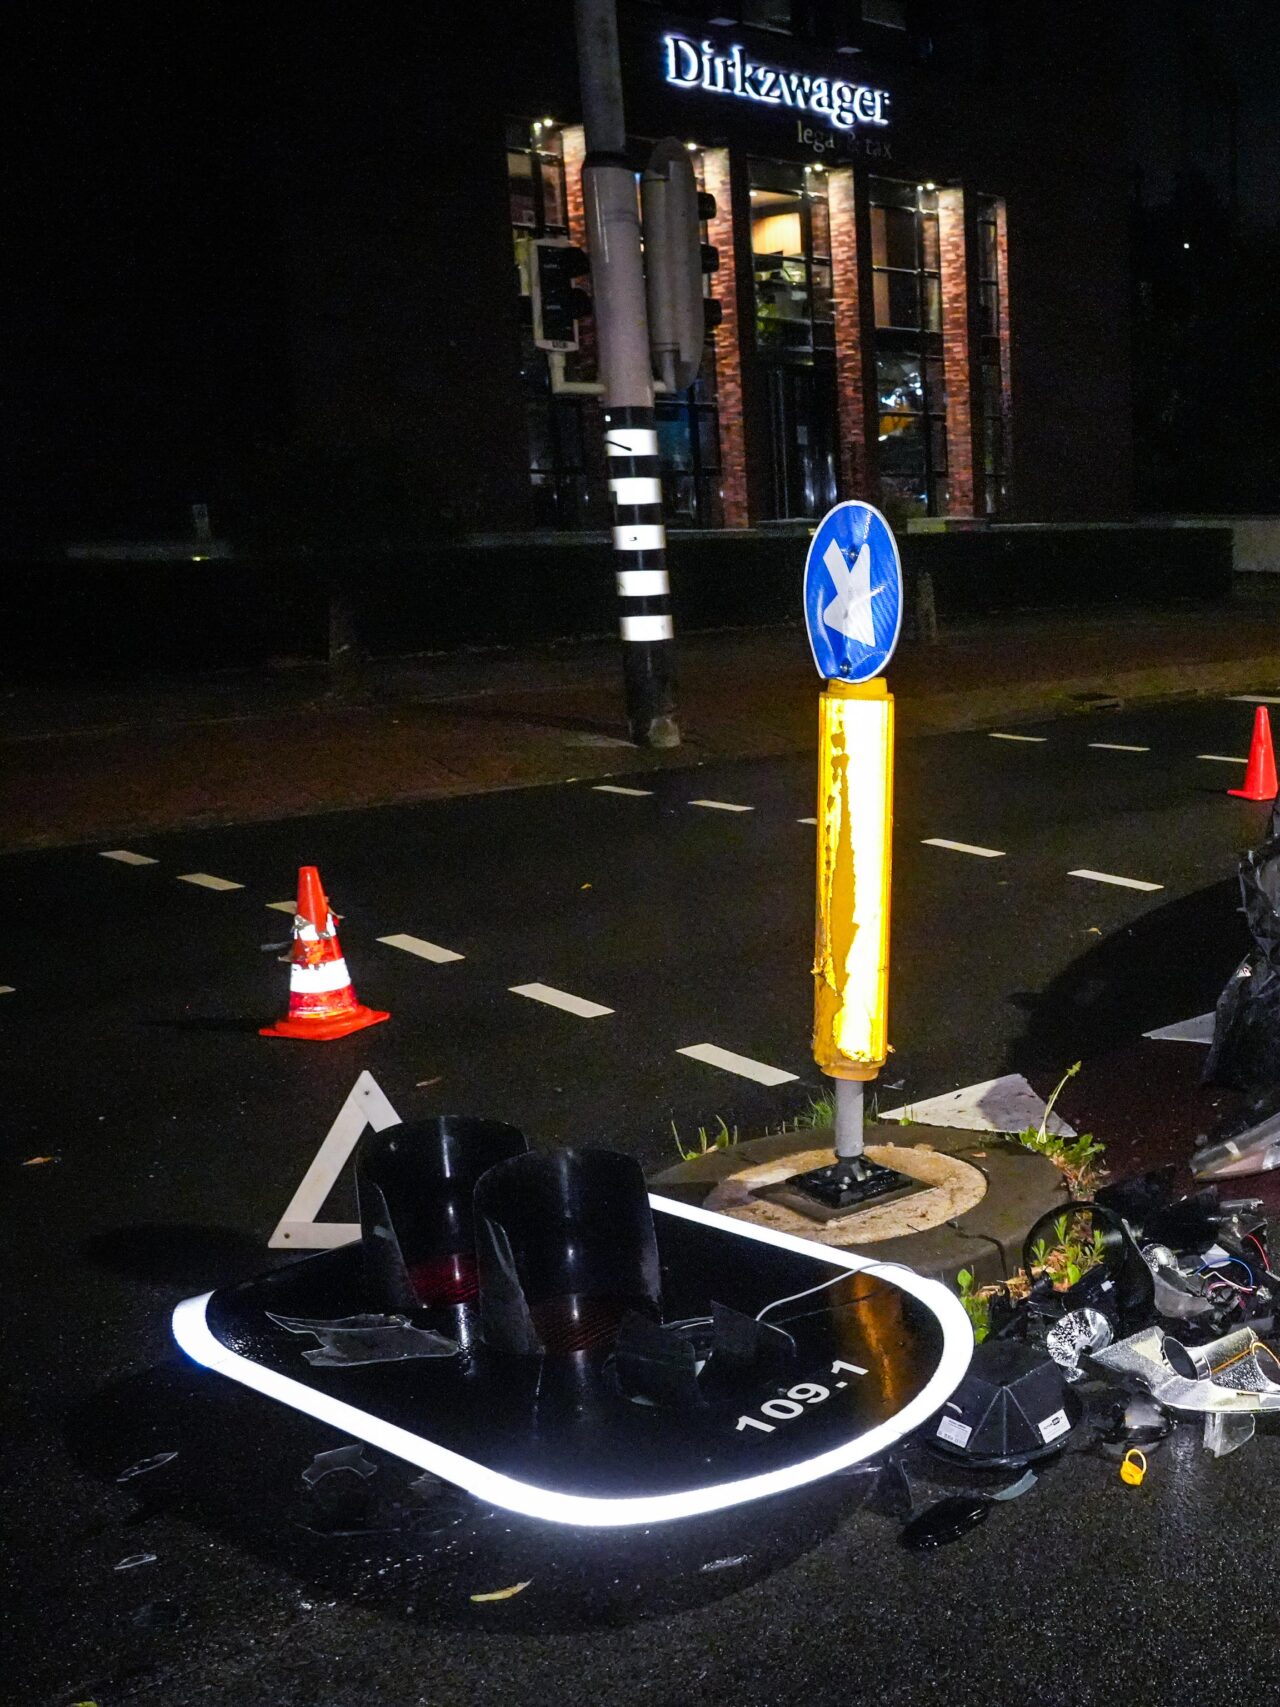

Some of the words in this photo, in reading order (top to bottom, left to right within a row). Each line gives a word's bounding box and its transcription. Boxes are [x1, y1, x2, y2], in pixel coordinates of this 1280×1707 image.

[662, 33, 891, 129] Dirkzwager
[797, 119, 838, 153] lega
[735, 1359, 870, 1434] 109.1
